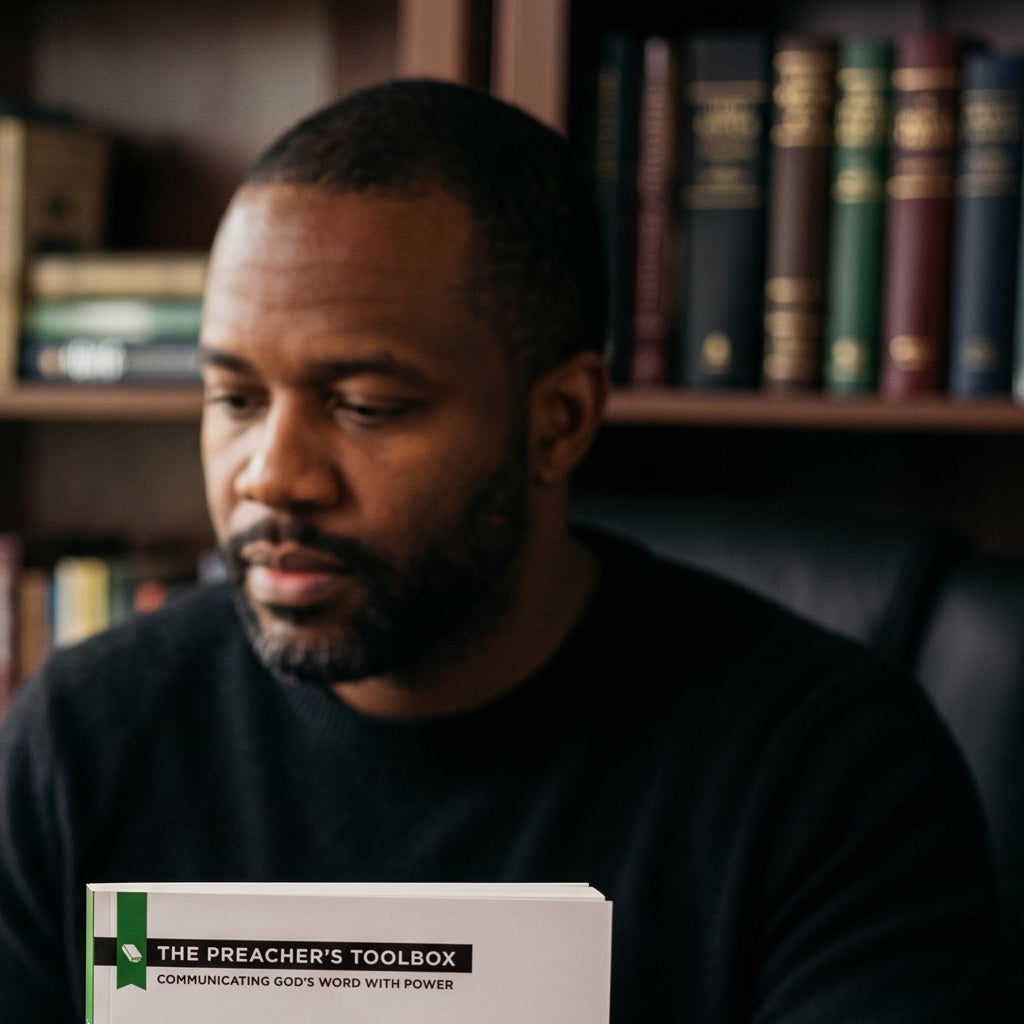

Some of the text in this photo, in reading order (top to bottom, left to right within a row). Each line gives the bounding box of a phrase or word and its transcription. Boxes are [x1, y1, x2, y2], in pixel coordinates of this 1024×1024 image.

[157, 945, 456, 967] THE PREACHER’S TOOLBOX
[157, 974, 454, 990] COMMUNICATING GOD'S WORD WITH POWER
